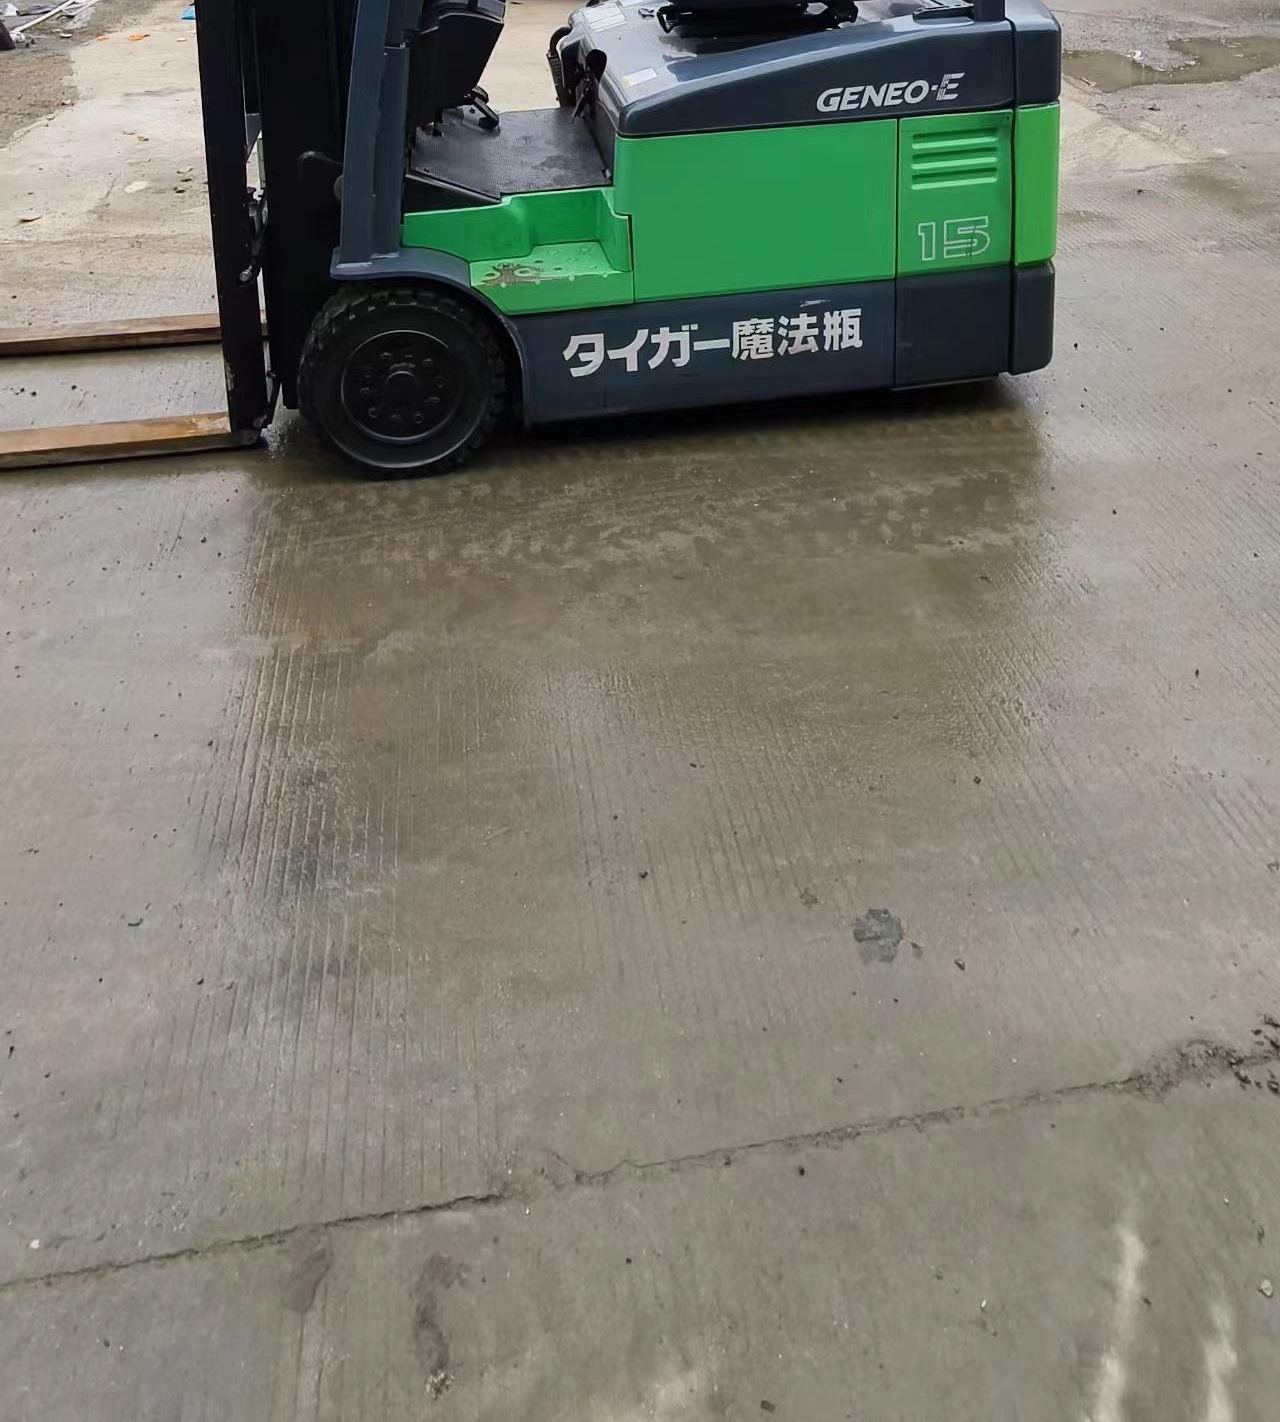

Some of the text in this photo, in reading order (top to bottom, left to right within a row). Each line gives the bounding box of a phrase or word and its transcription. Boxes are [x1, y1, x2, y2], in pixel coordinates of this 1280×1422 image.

[917, 215, 991, 262] 15
[562, 308, 863, 378] タイガー魔法瓶
